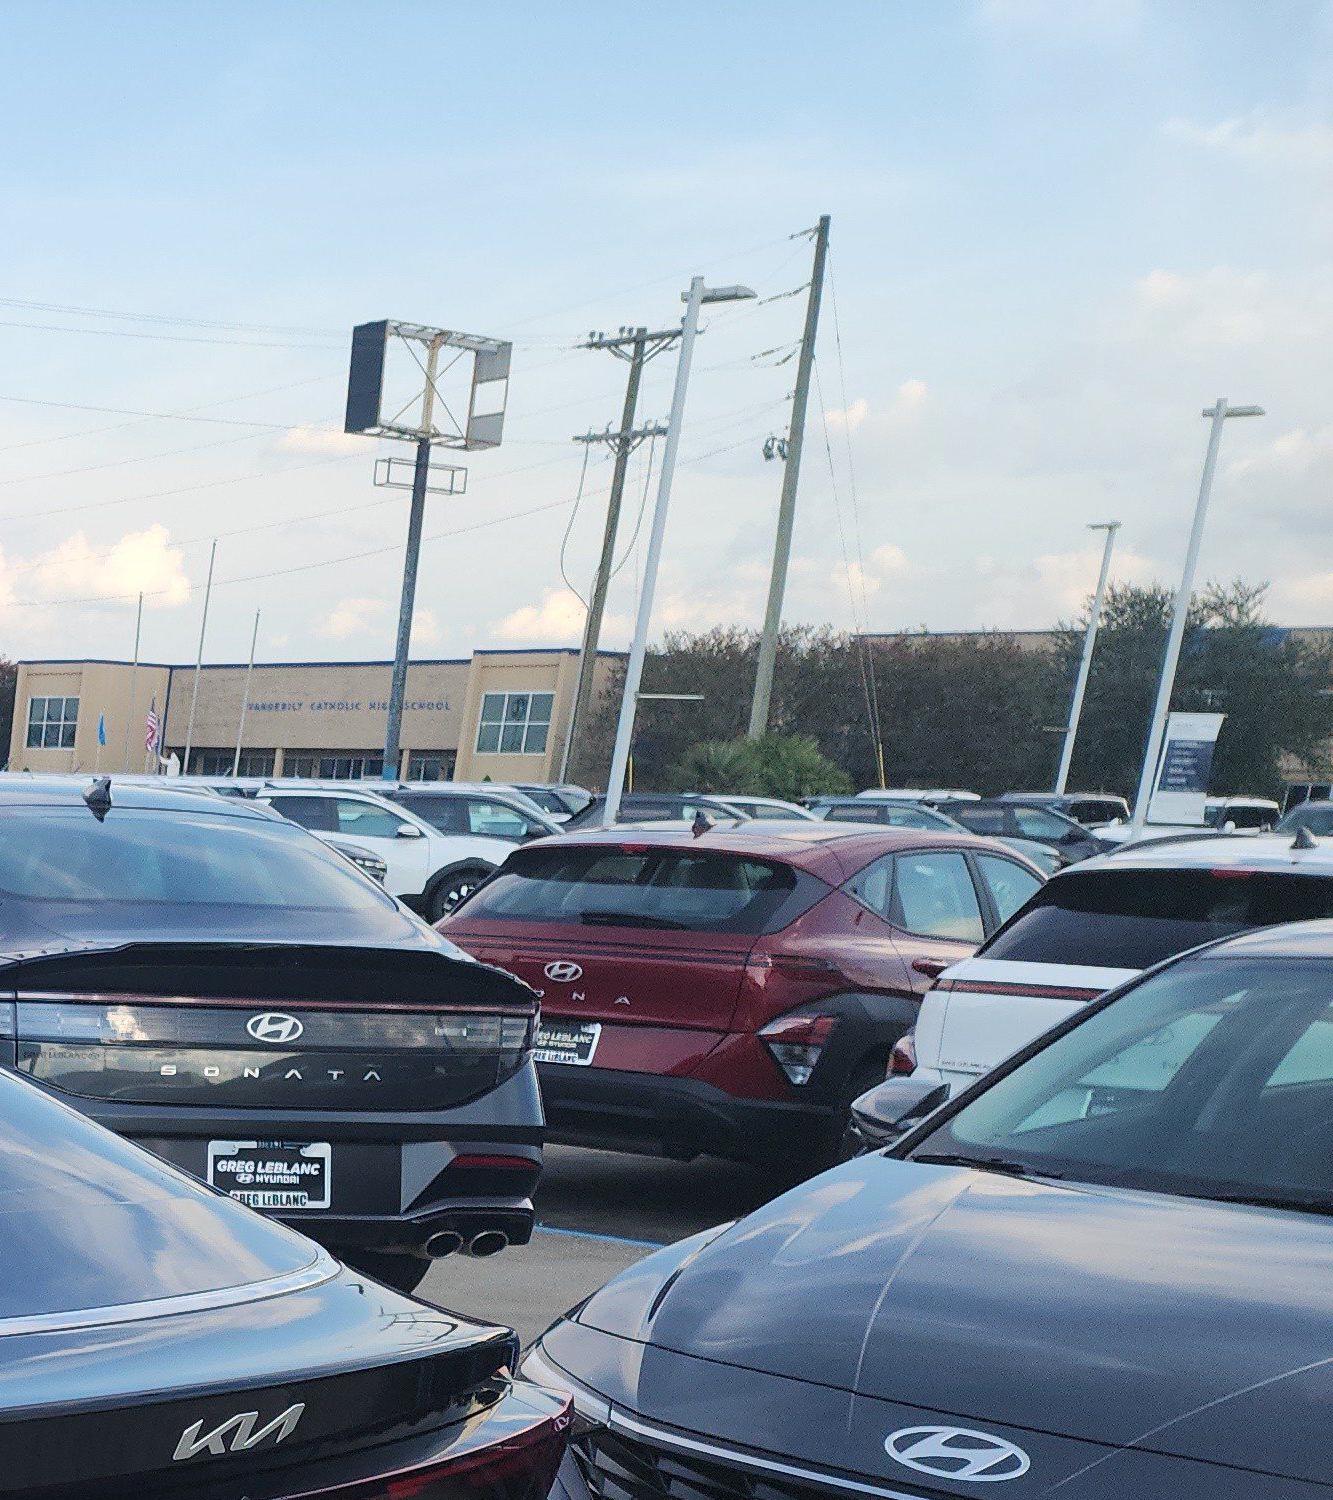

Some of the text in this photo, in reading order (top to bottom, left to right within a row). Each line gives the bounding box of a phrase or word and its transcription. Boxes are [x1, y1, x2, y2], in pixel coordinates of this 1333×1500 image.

[310, 701, 361, 711] CATHOLIC
[368, 702, 392, 711] HIG
[403, 701, 450, 711] SCHOOL
[160, 1063, 383, 1082] SONATA
[216, 1160, 321, 1176] GREG LEBLANC
[255, 1174, 300, 1185] HYUNDAI
[173, 1403, 306, 1461] KIA
